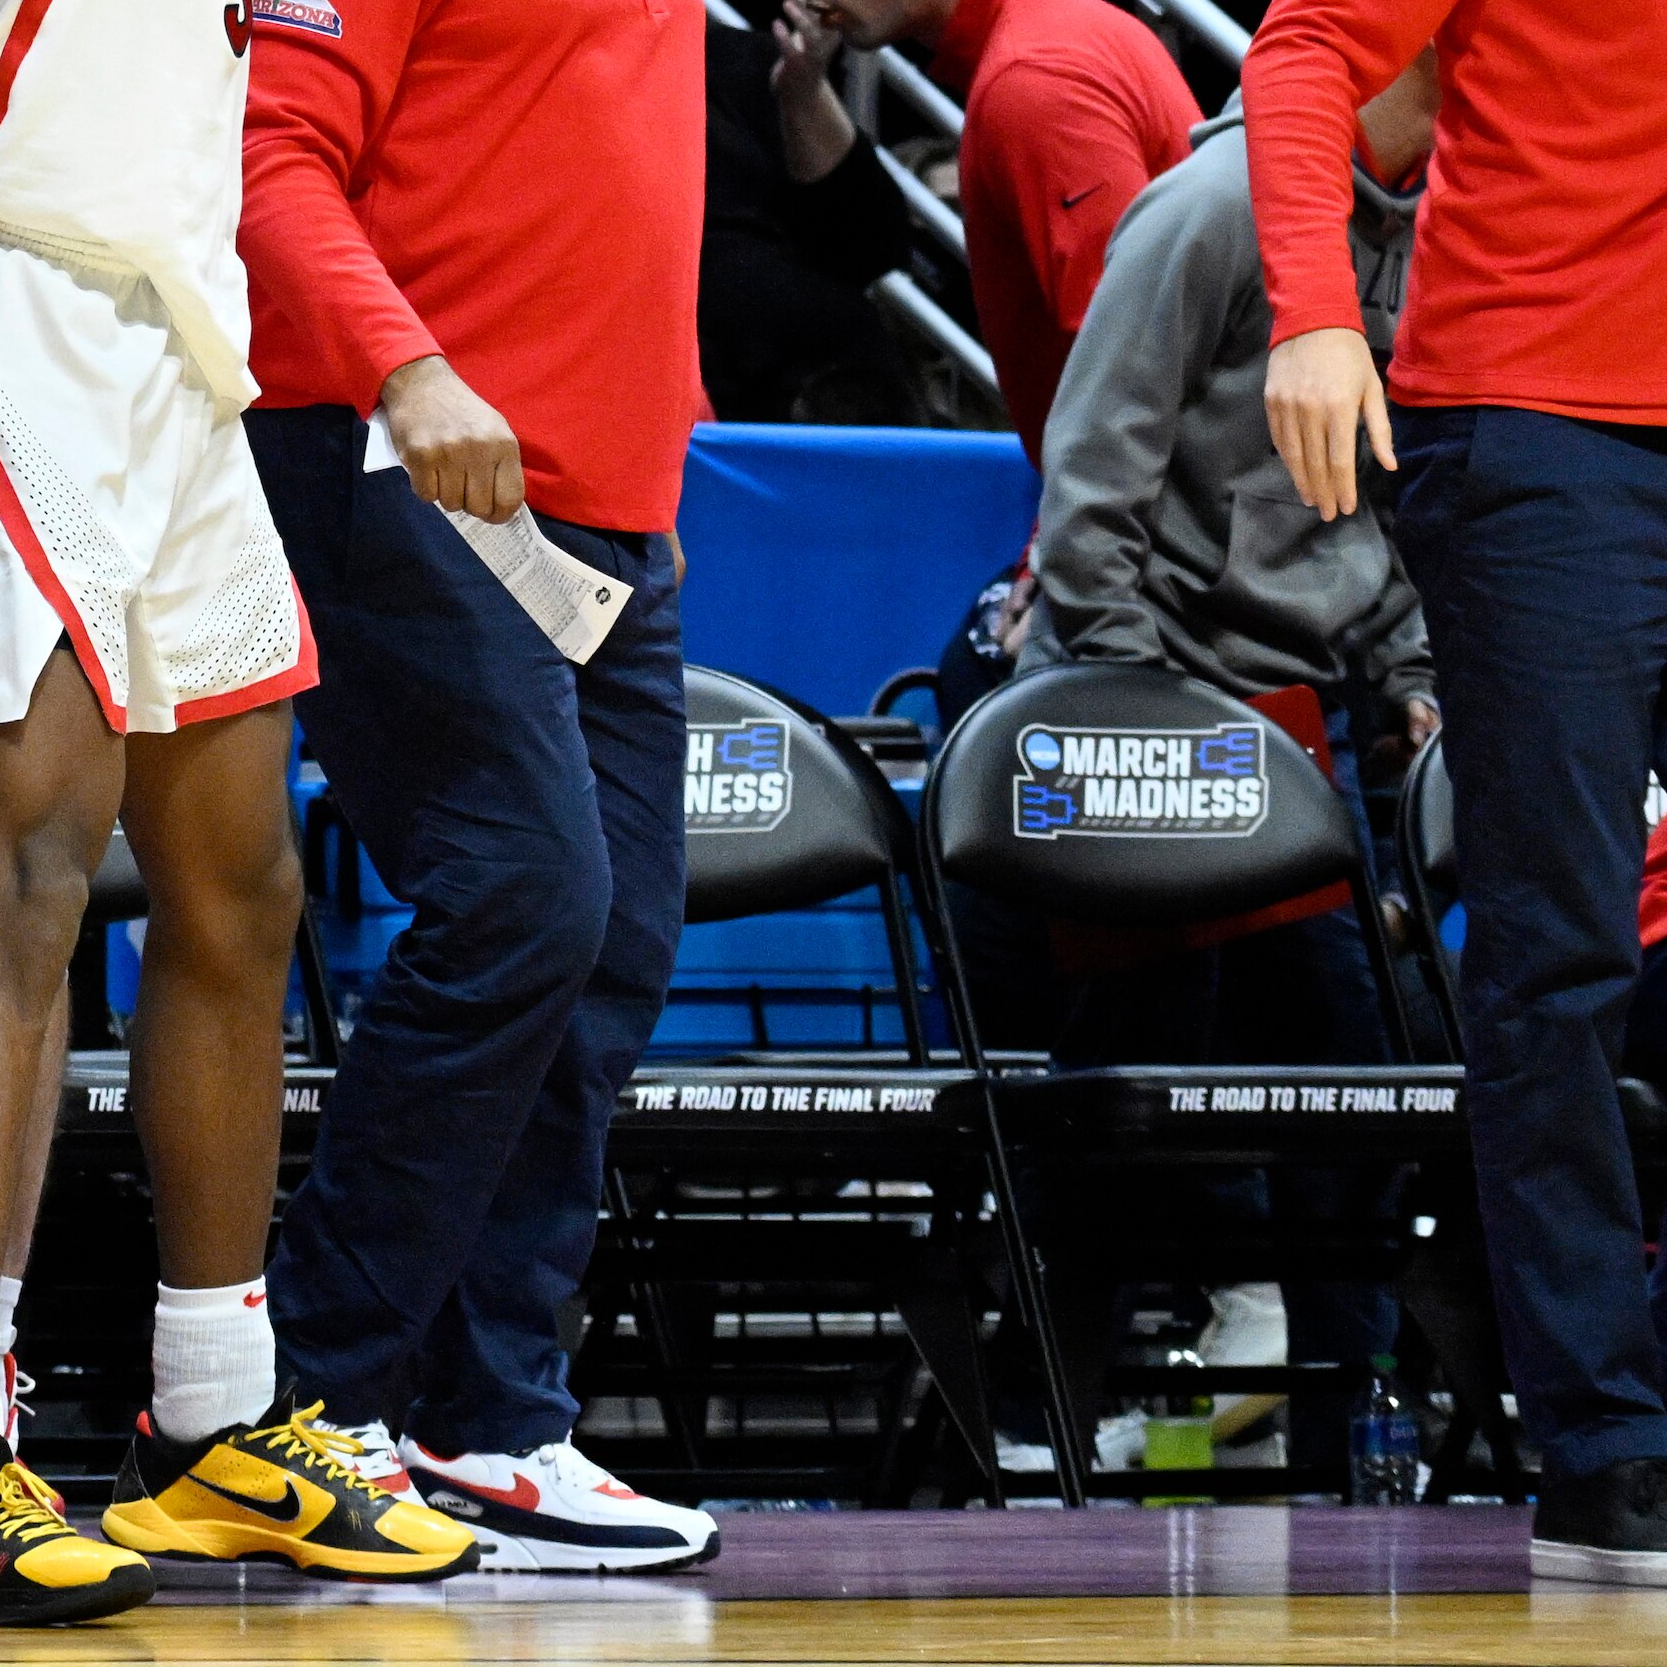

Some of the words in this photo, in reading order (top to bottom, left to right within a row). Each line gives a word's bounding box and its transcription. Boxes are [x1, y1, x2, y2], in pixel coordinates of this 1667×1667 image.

[1063, 736, 1192, 778] MARCH
[1084, 777, 1262, 819] MADNESS
[88, 1087, 127, 1112] THE
[634, 1086, 676, 1111] THE
[679, 1086, 737, 1111] ROAD
[740, 1086, 767, 1111] TO
[772, 1086, 812, 1111] THE
[815, 1086, 873, 1112] FINAL
[879, 1087, 935, 1112] FOUR
[1169, 1086, 1208, 1112] THE
[1211, 1086, 1266, 1112] ROAD
[1269, 1086, 1296, 1112] TO
[1299, 1086, 1338, 1112] THE
[1341, 1086, 1397, 1112] FINAL
[1402, 1086, 1456, 1112] FOUR
